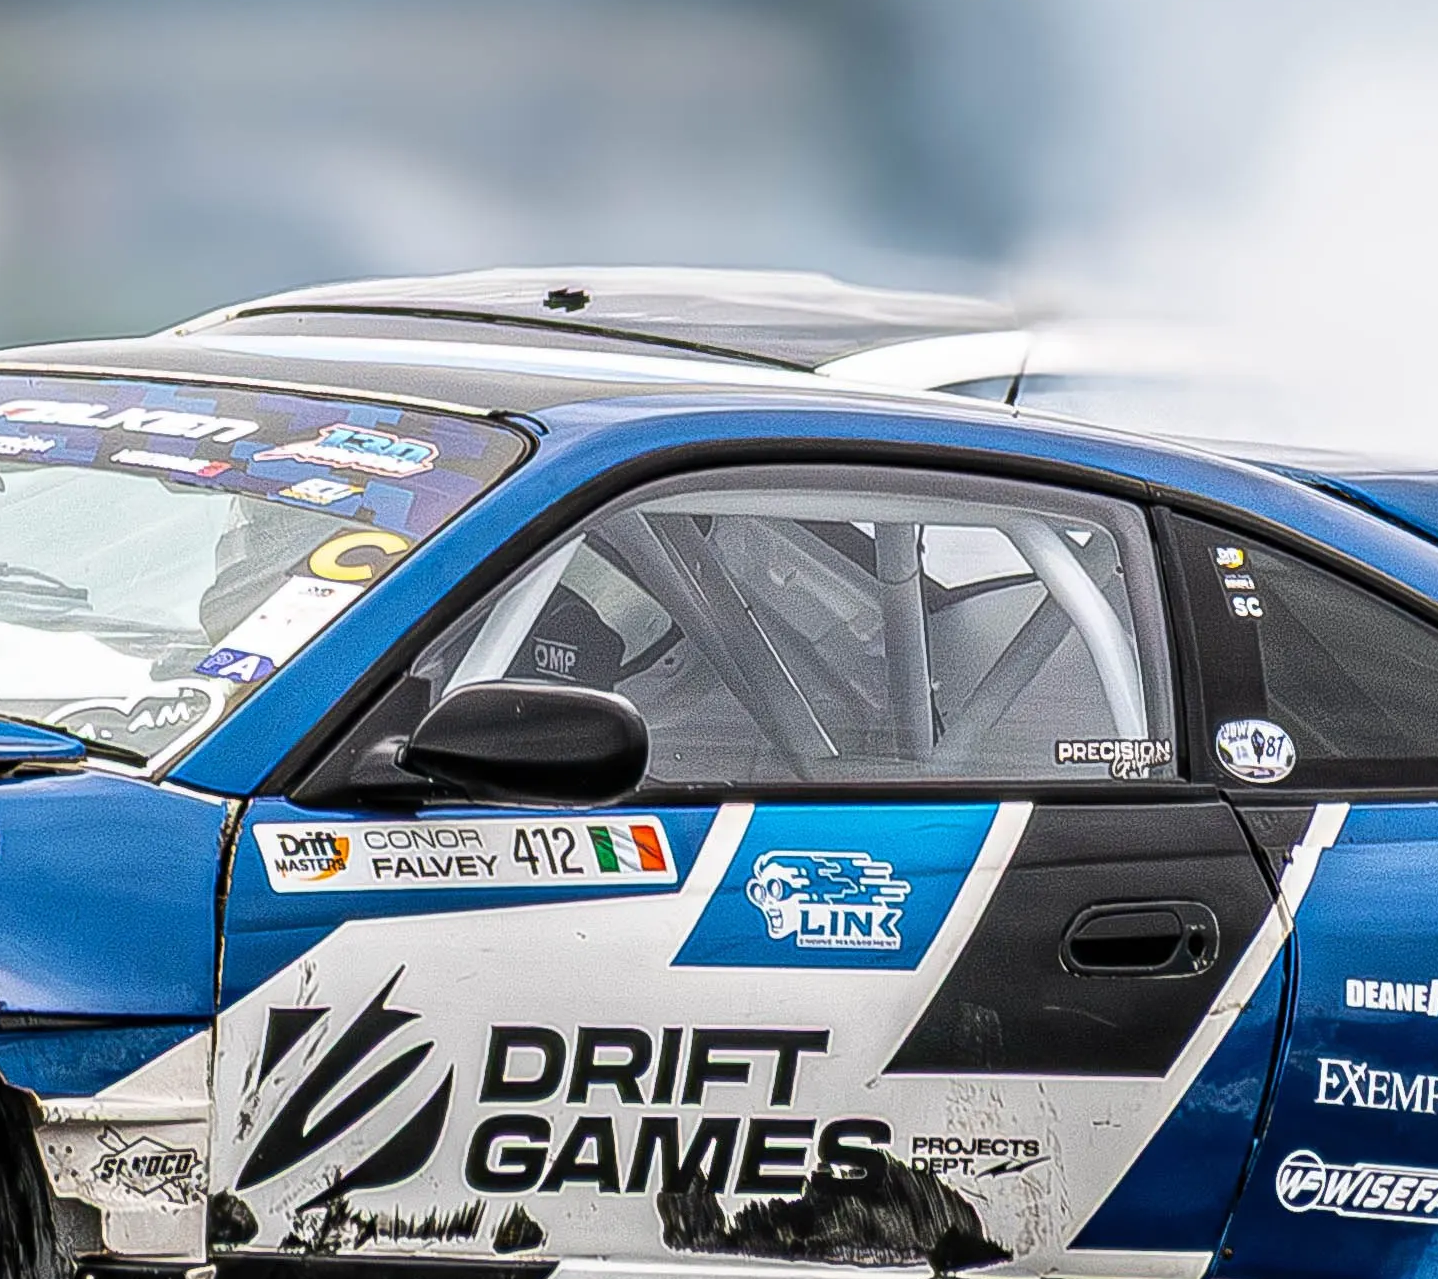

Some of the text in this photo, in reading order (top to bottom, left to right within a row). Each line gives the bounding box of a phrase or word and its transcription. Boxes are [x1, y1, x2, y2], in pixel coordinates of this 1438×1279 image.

[308, 529, 410, 581] C
[1232, 596, 1264, 618] SC
[534, 643, 577, 674] OMP
[1058, 740, 1171, 763] PRECISION
[280, 831, 341, 857] Drift
[363, 828, 485, 850] CONOR
[512, 827, 585, 877] 412
[275, 856, 347, 874] MASTERS
[372, 856, 498, 879] FALVEY
[800, 910, 899, 937] LINK
[478, 1025, 830, 1108] DRIFT
[465, 1114, 892, 1196] GAMES
[912, 1137, 1040, 1158] PROJECTS
[912, 1157, 976, 1176] DEPT.
